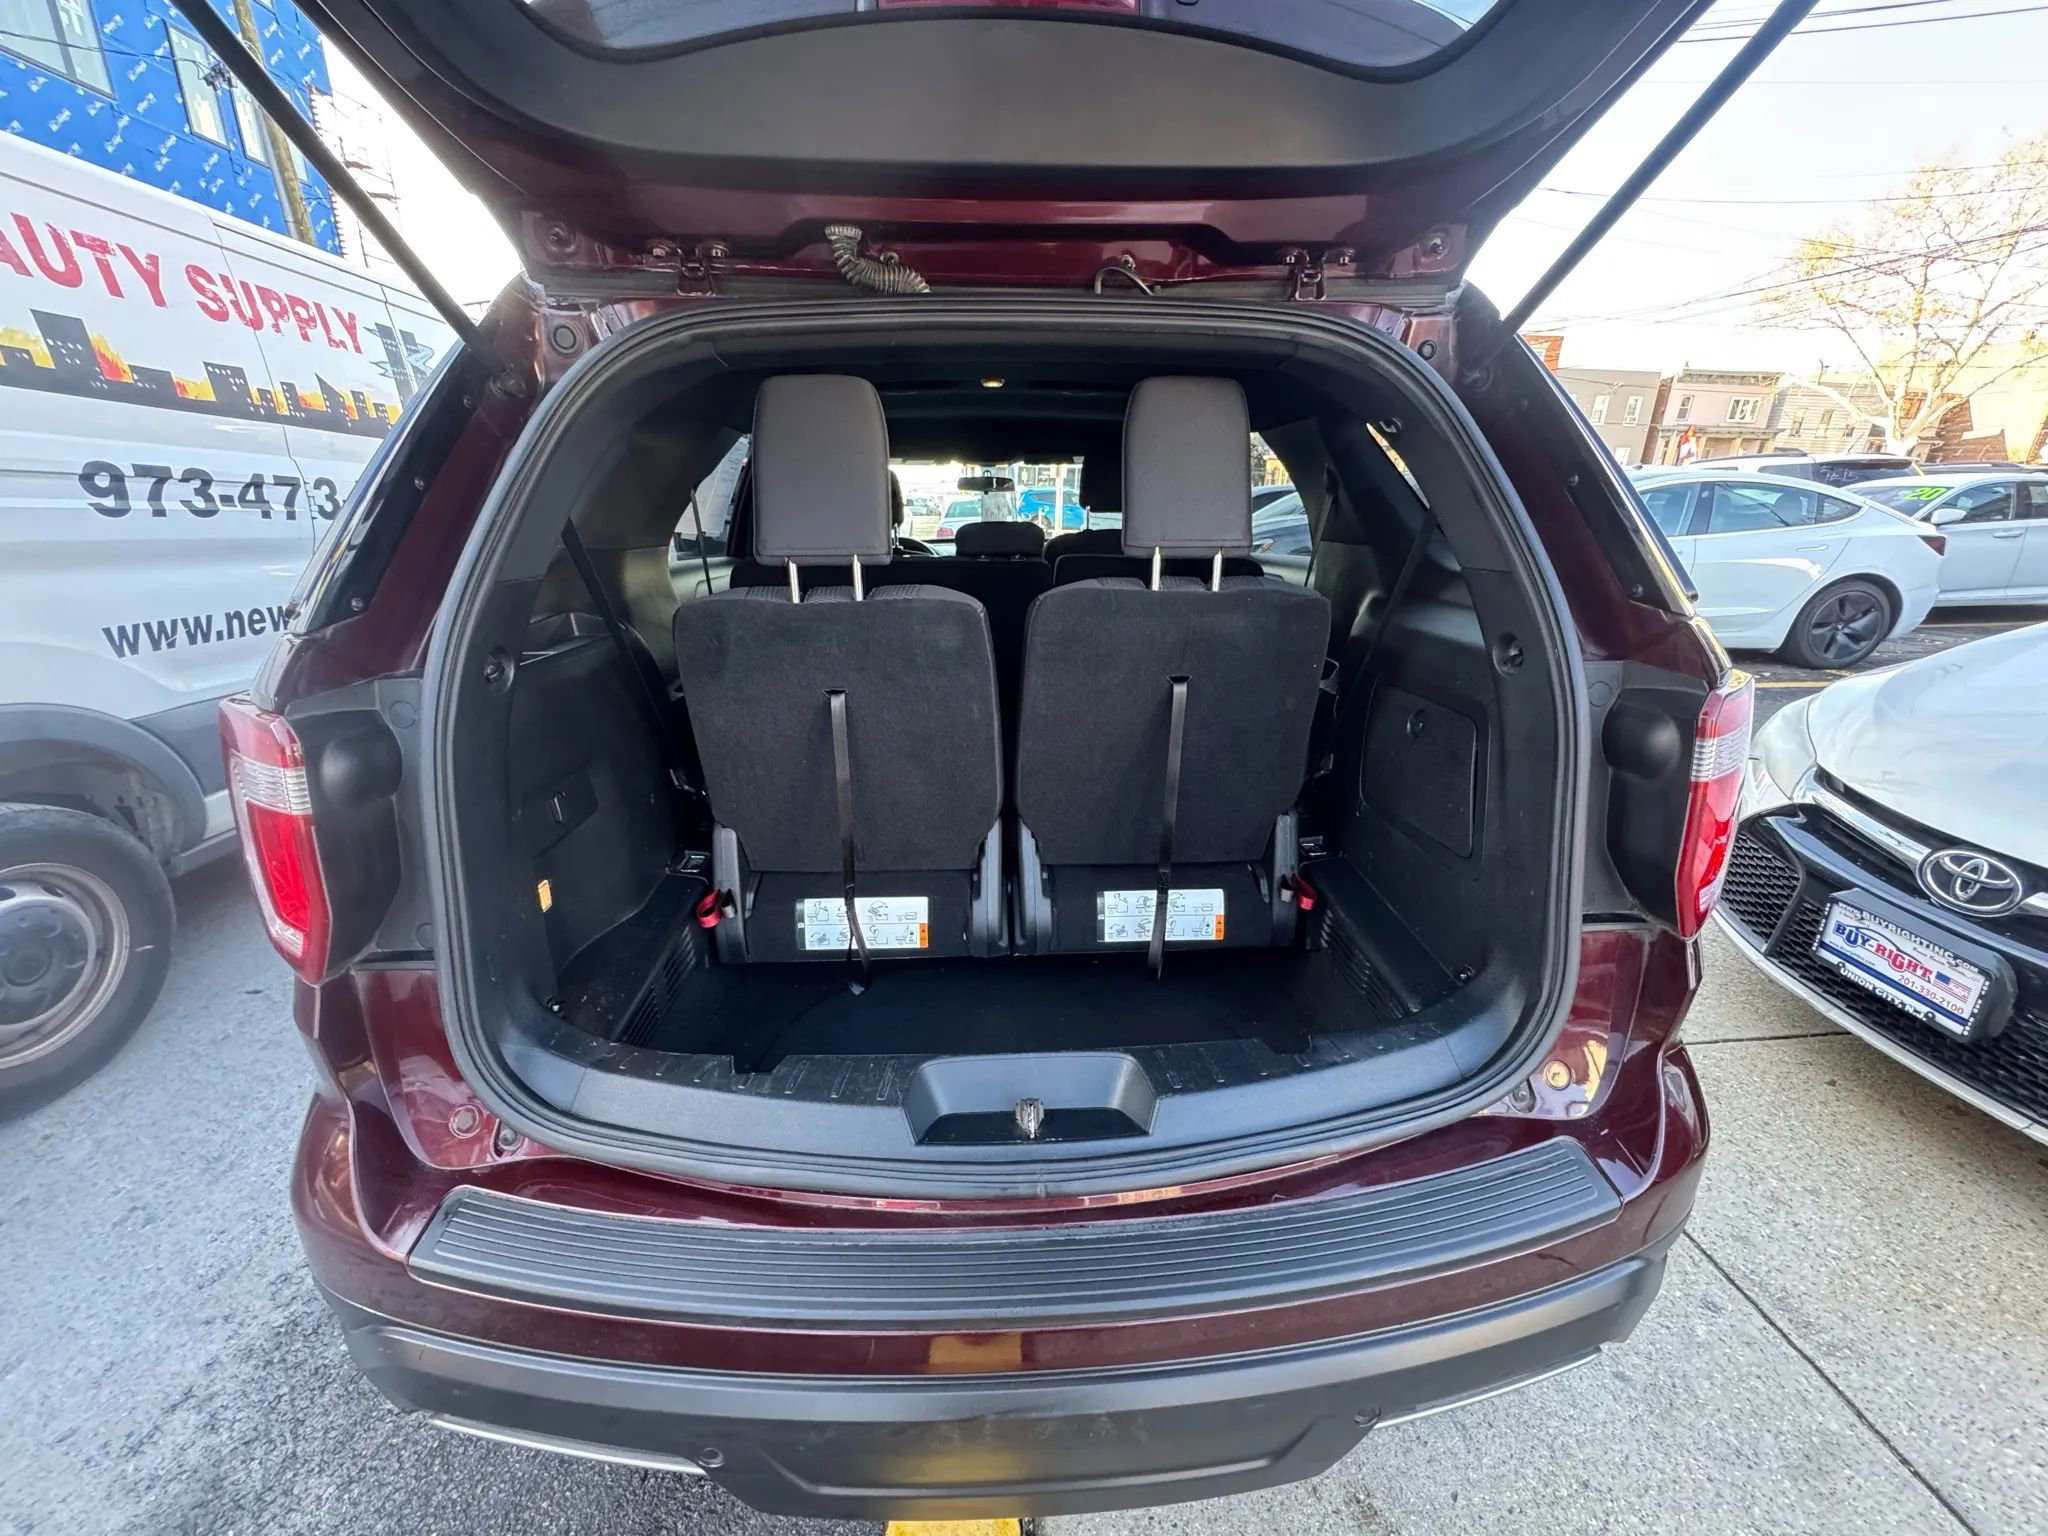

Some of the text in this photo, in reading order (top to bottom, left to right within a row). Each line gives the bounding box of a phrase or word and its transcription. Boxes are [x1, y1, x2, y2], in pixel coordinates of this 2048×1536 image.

[184, 263, 363, 354] SUPPLY
[78, 460, 349, 521] 973-473
[1904, 487, 1948, 501] 20
[1833, 921, 1934, 979] BUY-RIGHT
[1839, 966, 1875, 991] UNION
[1898, 974, 1965, 1015] 201-330-2100
